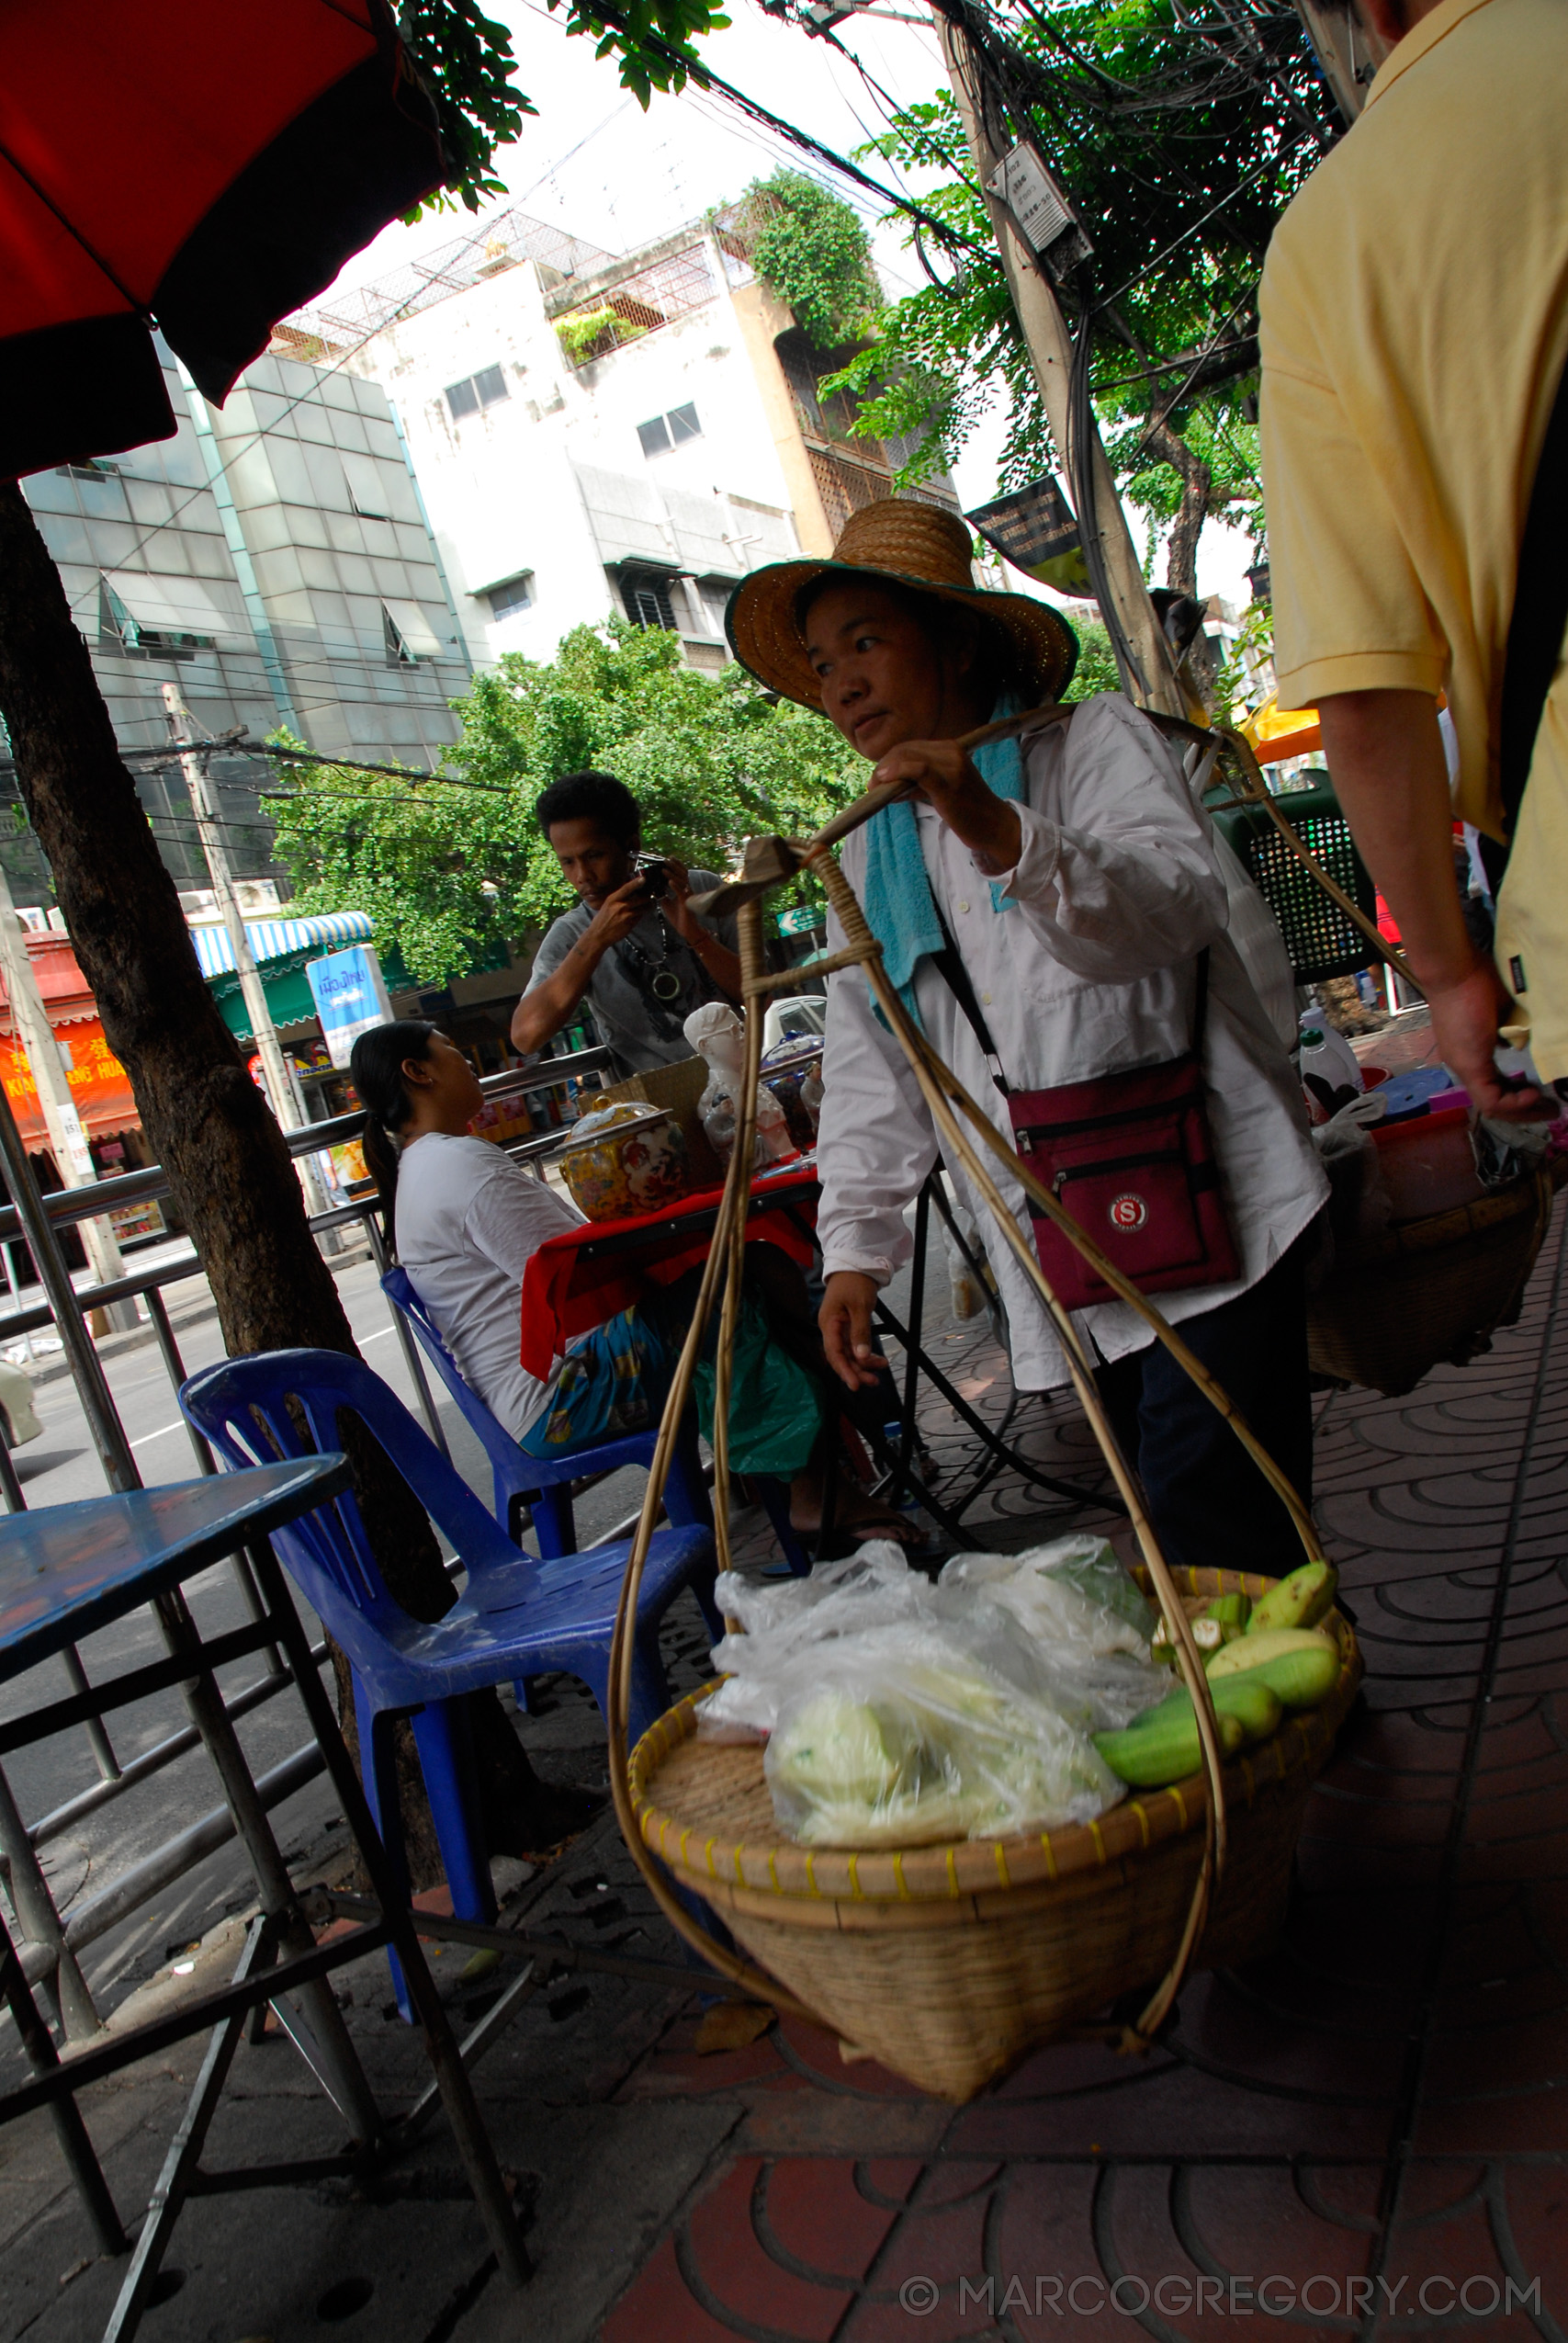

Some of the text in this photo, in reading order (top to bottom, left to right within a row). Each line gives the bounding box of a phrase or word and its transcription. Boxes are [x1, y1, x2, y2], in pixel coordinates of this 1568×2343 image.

[319, 970, 366, 995] เมืองไทย
[1120, 1201, 1136, 1222] S
